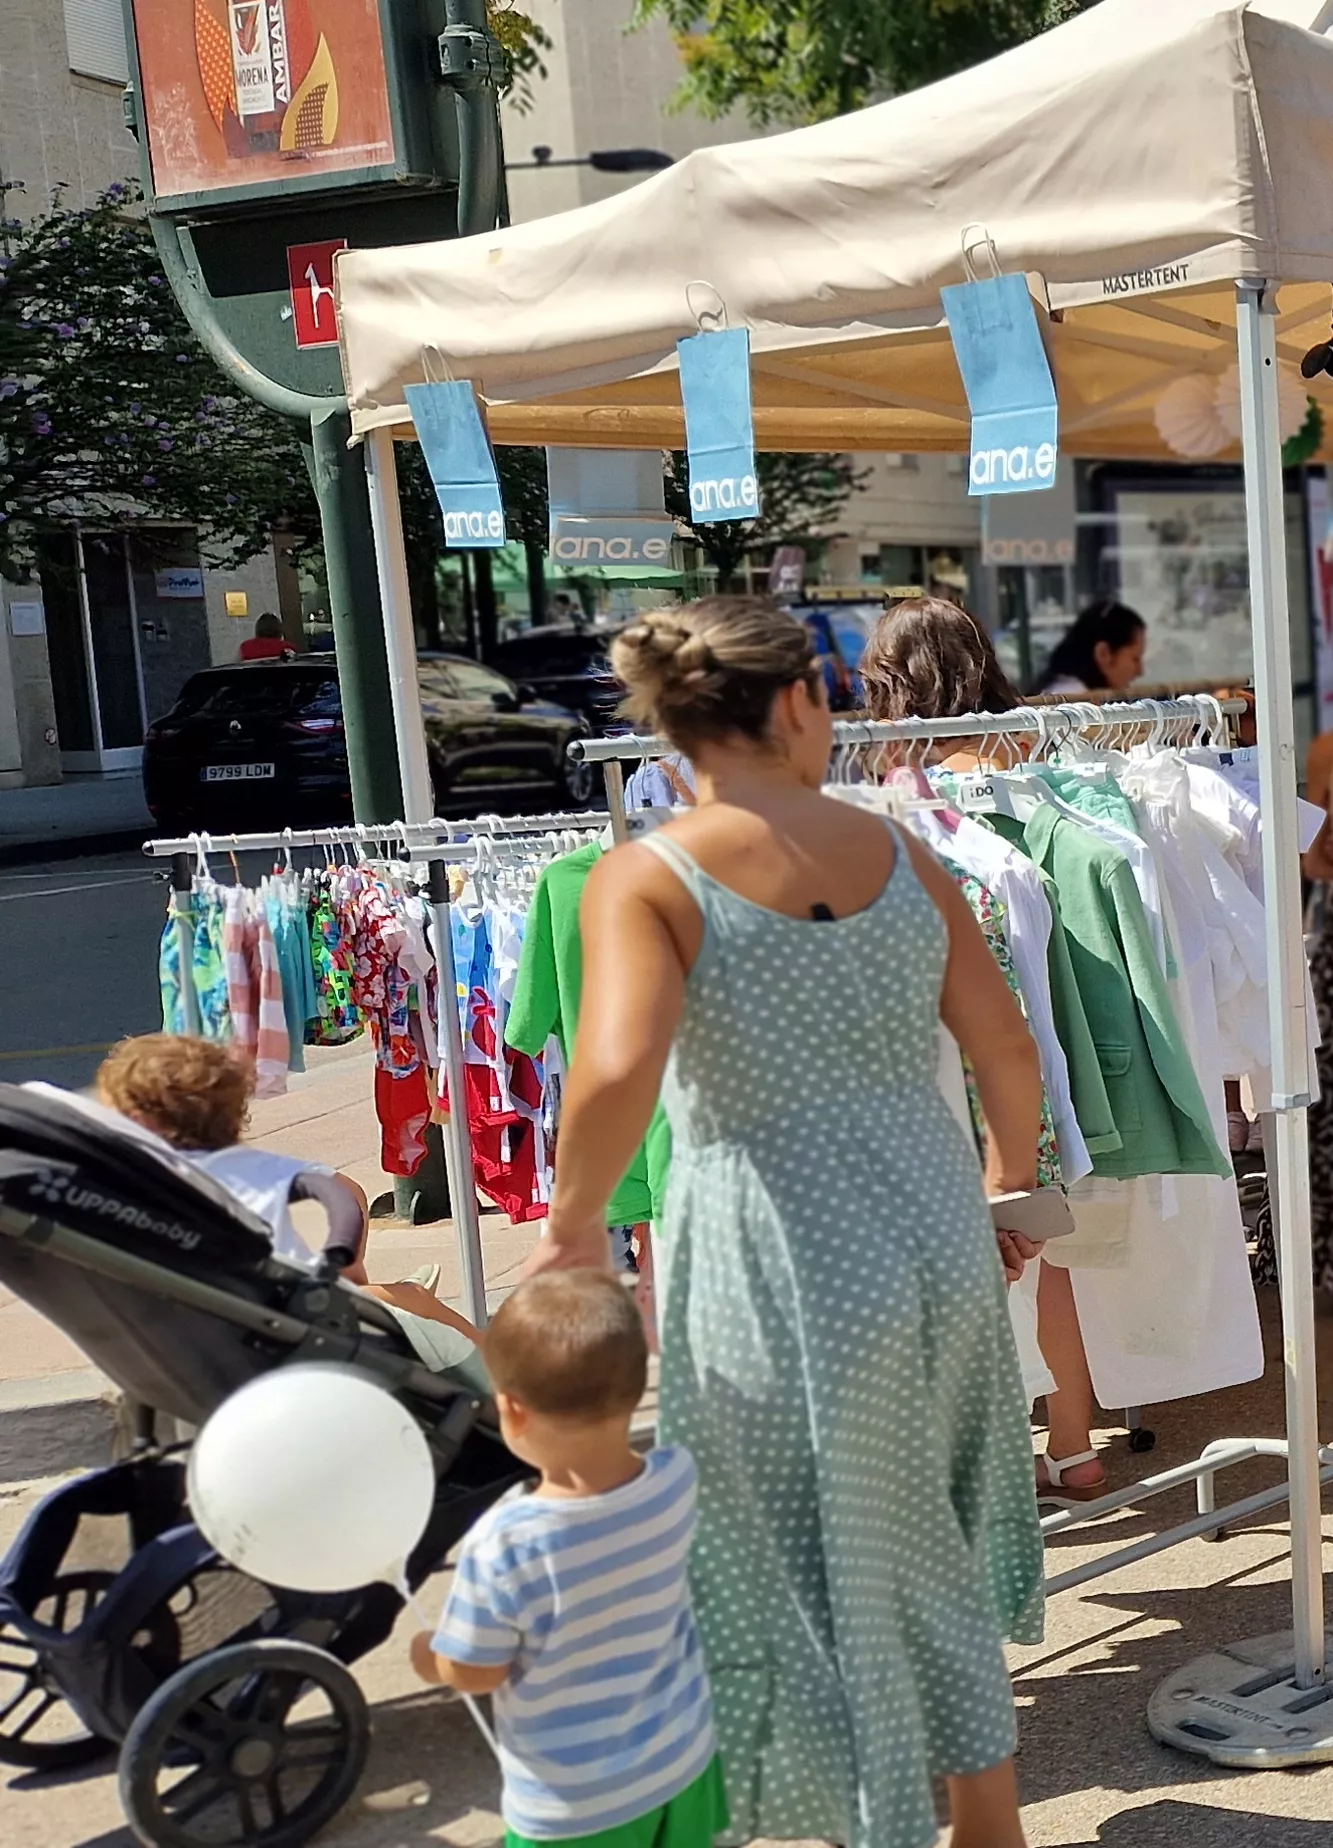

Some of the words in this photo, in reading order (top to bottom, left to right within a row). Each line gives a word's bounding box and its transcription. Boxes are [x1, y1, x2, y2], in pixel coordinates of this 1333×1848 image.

[268, 0, 288, 104] AMBAR
[1102, 264, 1189, 294] MASTERTENT
[971, 443, 1054, 485] ana.e
[691, 475, 757, 512] ana.e
[445, 511, 501, 538] ana.e
[555, 536, 667, 559] ana.e
[209, 767, 241, 779] 9799
